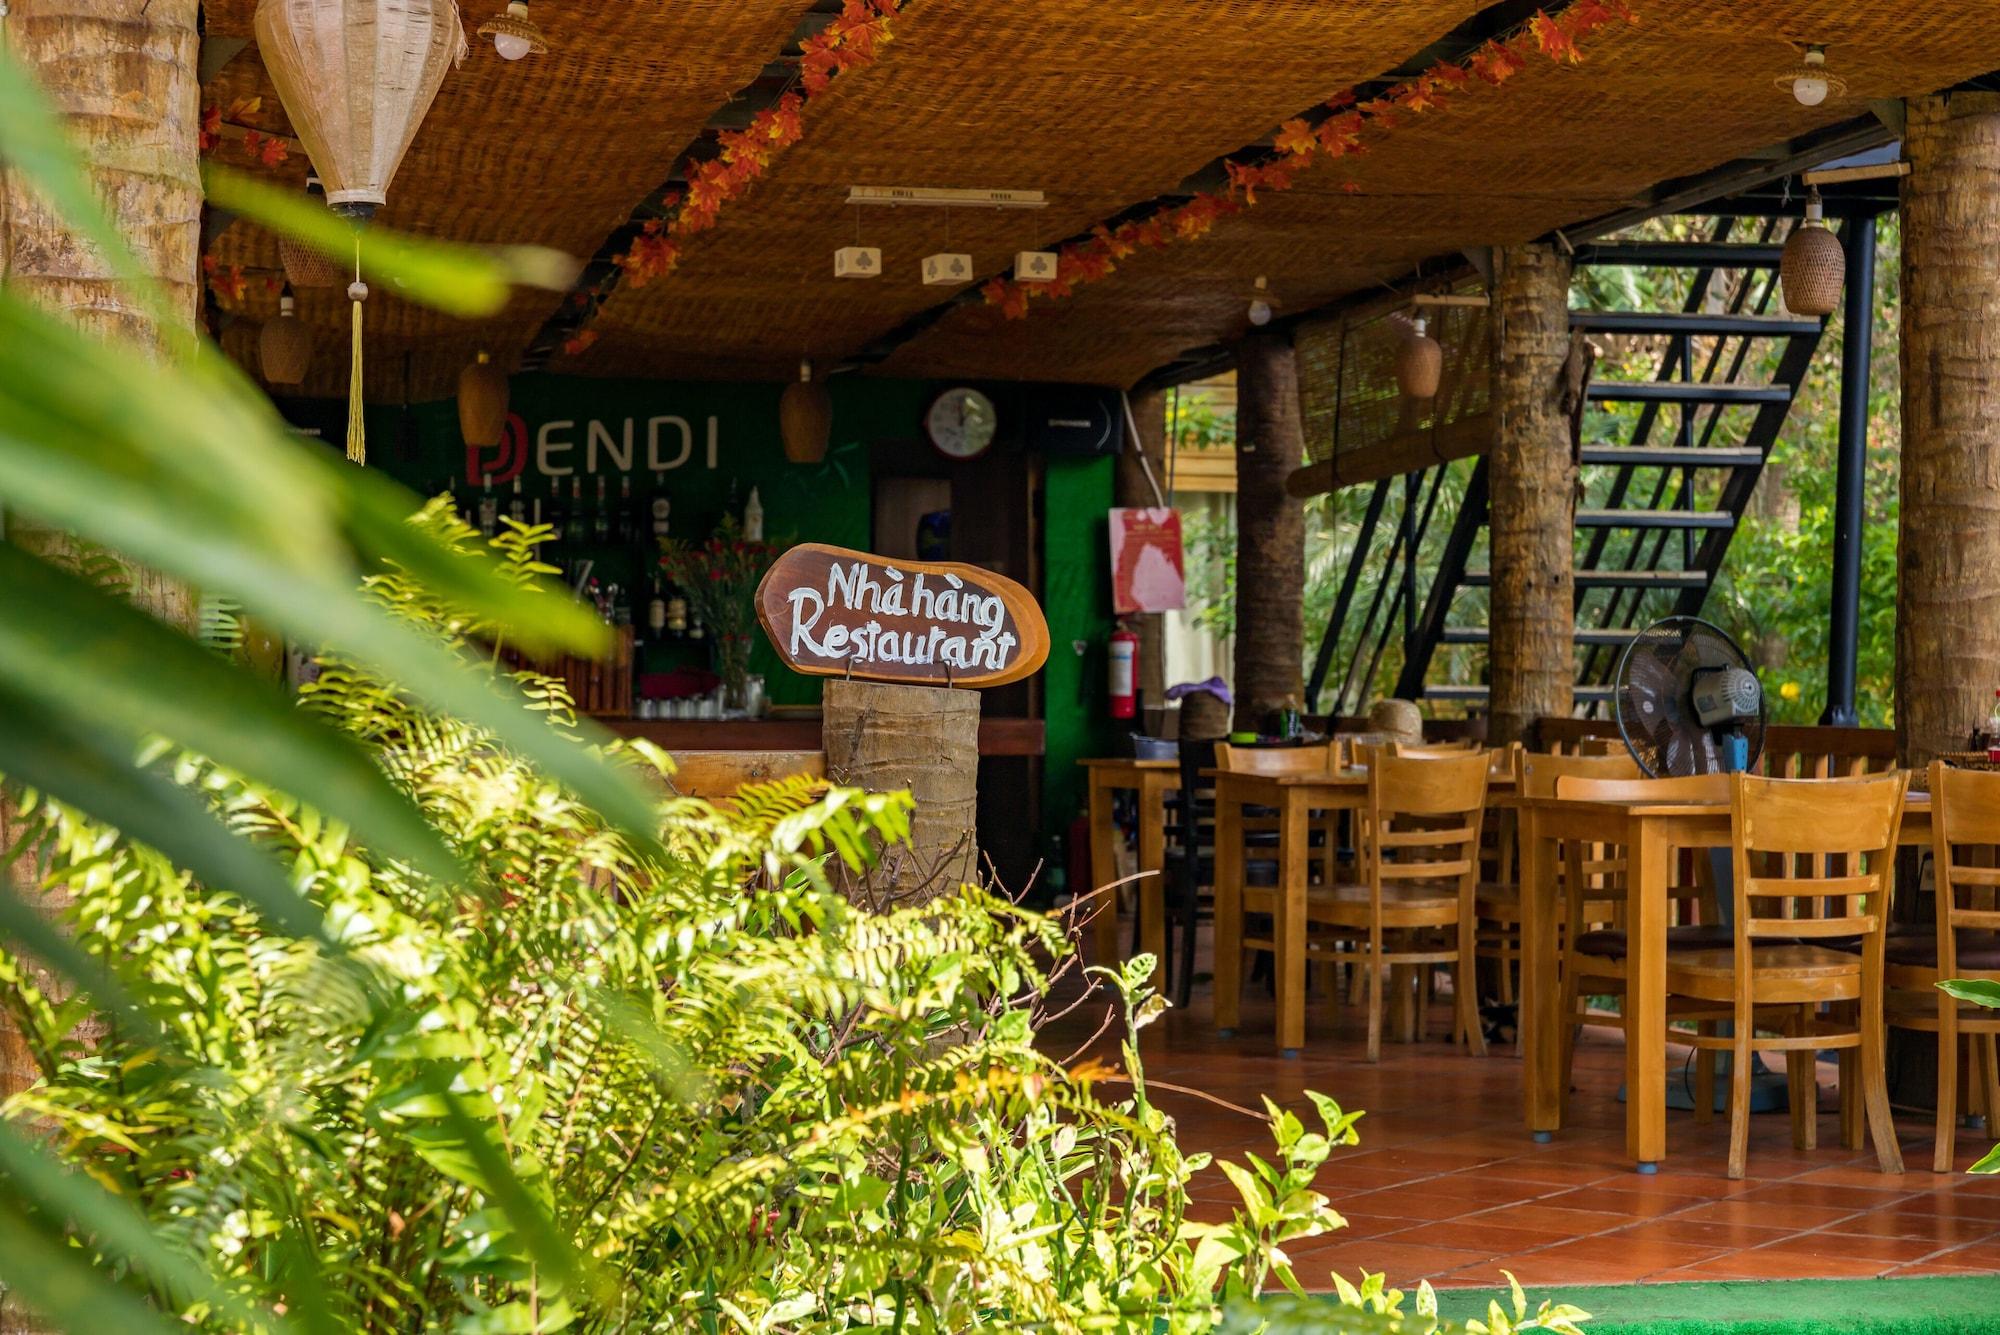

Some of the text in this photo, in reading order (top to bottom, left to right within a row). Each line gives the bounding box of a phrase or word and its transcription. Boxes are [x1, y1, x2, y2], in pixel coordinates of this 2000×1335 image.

[787, 587, 1017, 670] Restaurant
[827, 562, 1006, 640] Nhà hàng
